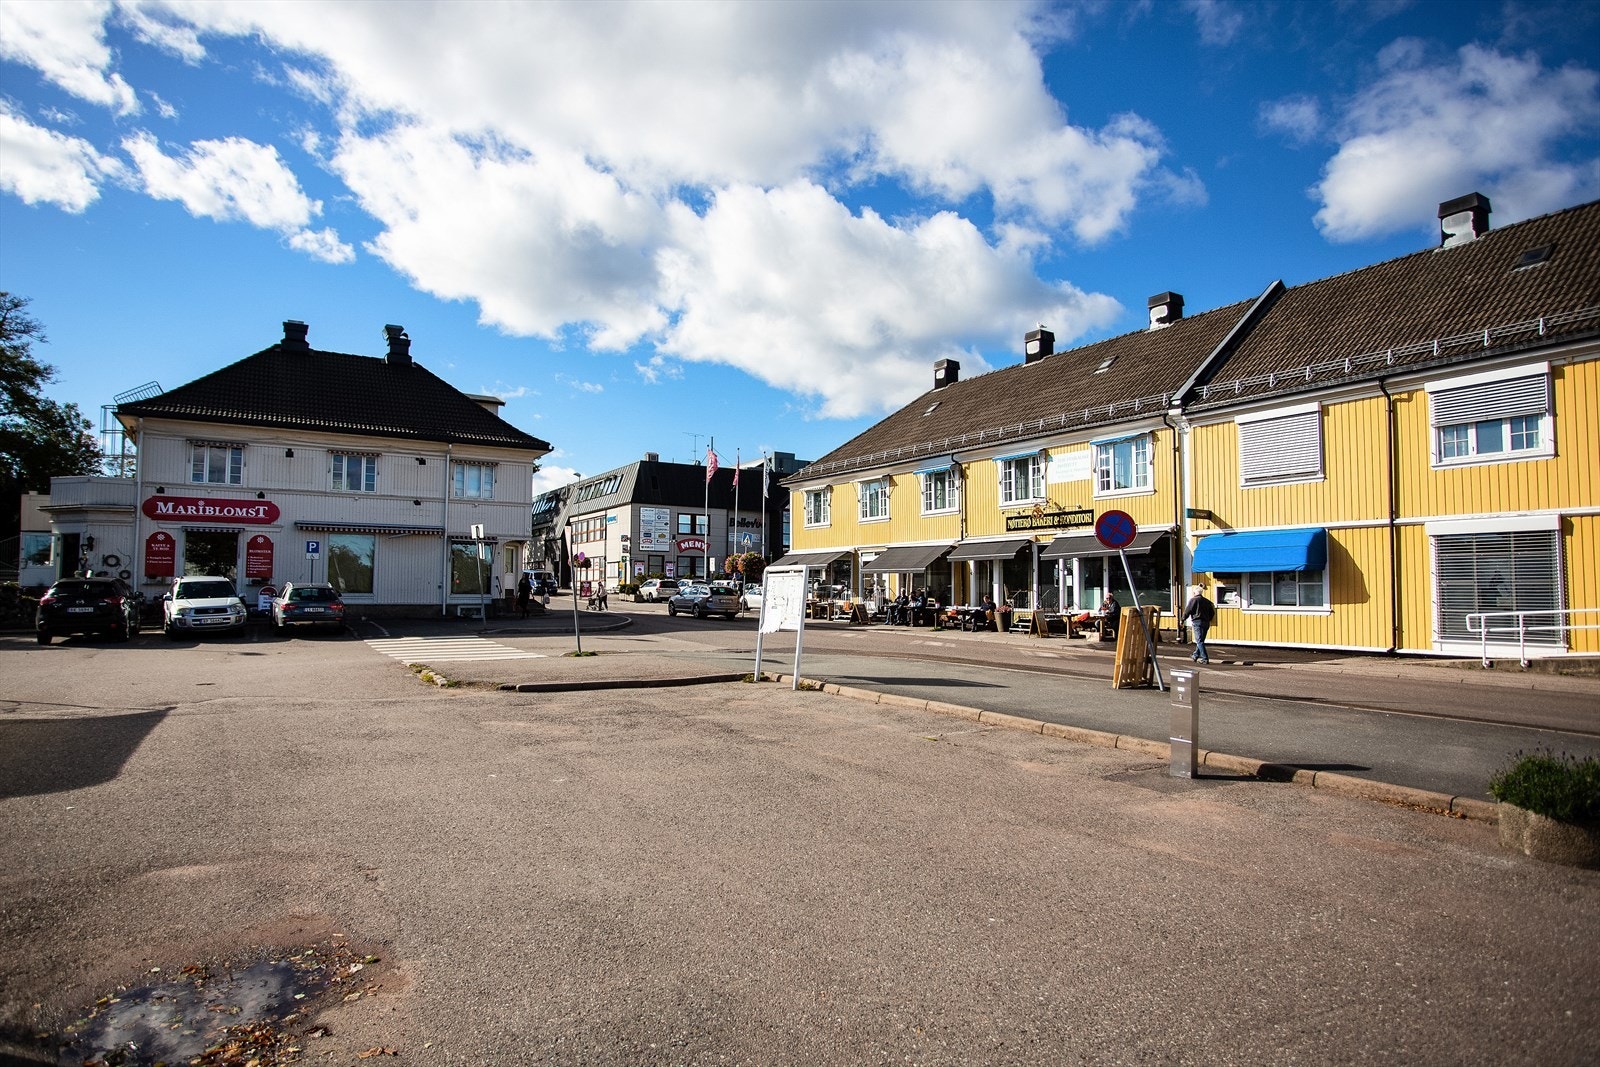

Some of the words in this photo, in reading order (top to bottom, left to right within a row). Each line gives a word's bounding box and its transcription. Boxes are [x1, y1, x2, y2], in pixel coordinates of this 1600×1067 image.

[156, 501, 268, 517] MARIBLOMST
[1032, 516, 1053, 527] BAKERI
[1053, 515, 1060, 525] &
[1060, 512, 1092, 525] KONDITORI
[309, 542, 317, 552] P
[680, 540, 708, 550] MENY
